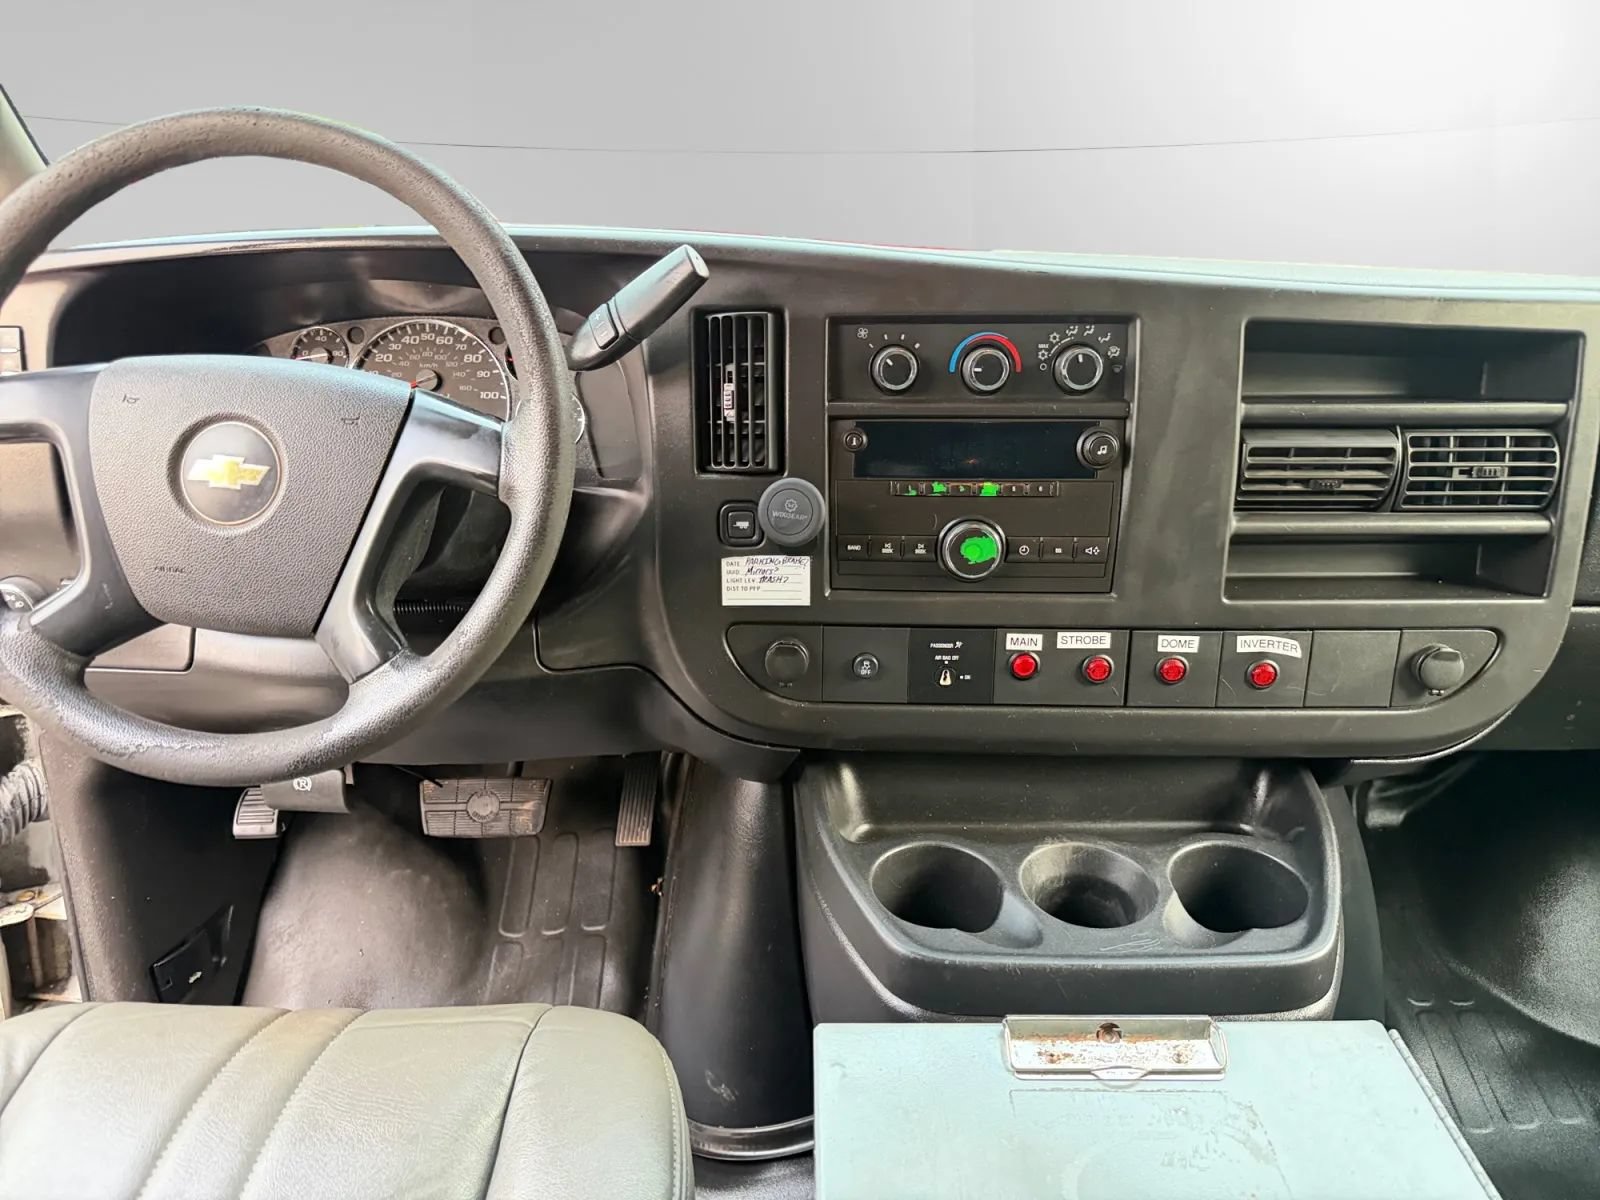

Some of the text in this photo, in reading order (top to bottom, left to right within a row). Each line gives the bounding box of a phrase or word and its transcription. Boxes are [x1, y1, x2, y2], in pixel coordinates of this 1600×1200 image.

[401, 336, 419, 344] 40
[436, 336, 453, 344] 60
[375, 353, 392, 362] 20
[464, 354, 482, 363] 80
[480, 391, 499, 399] 100
[1010, 637, 1038, 646] MAIN
[1060, 636, 1106, 644] STROBE
[1161, 639, 1195, 648] DOME
[1240, 640, 1298, 652] INVERTER
